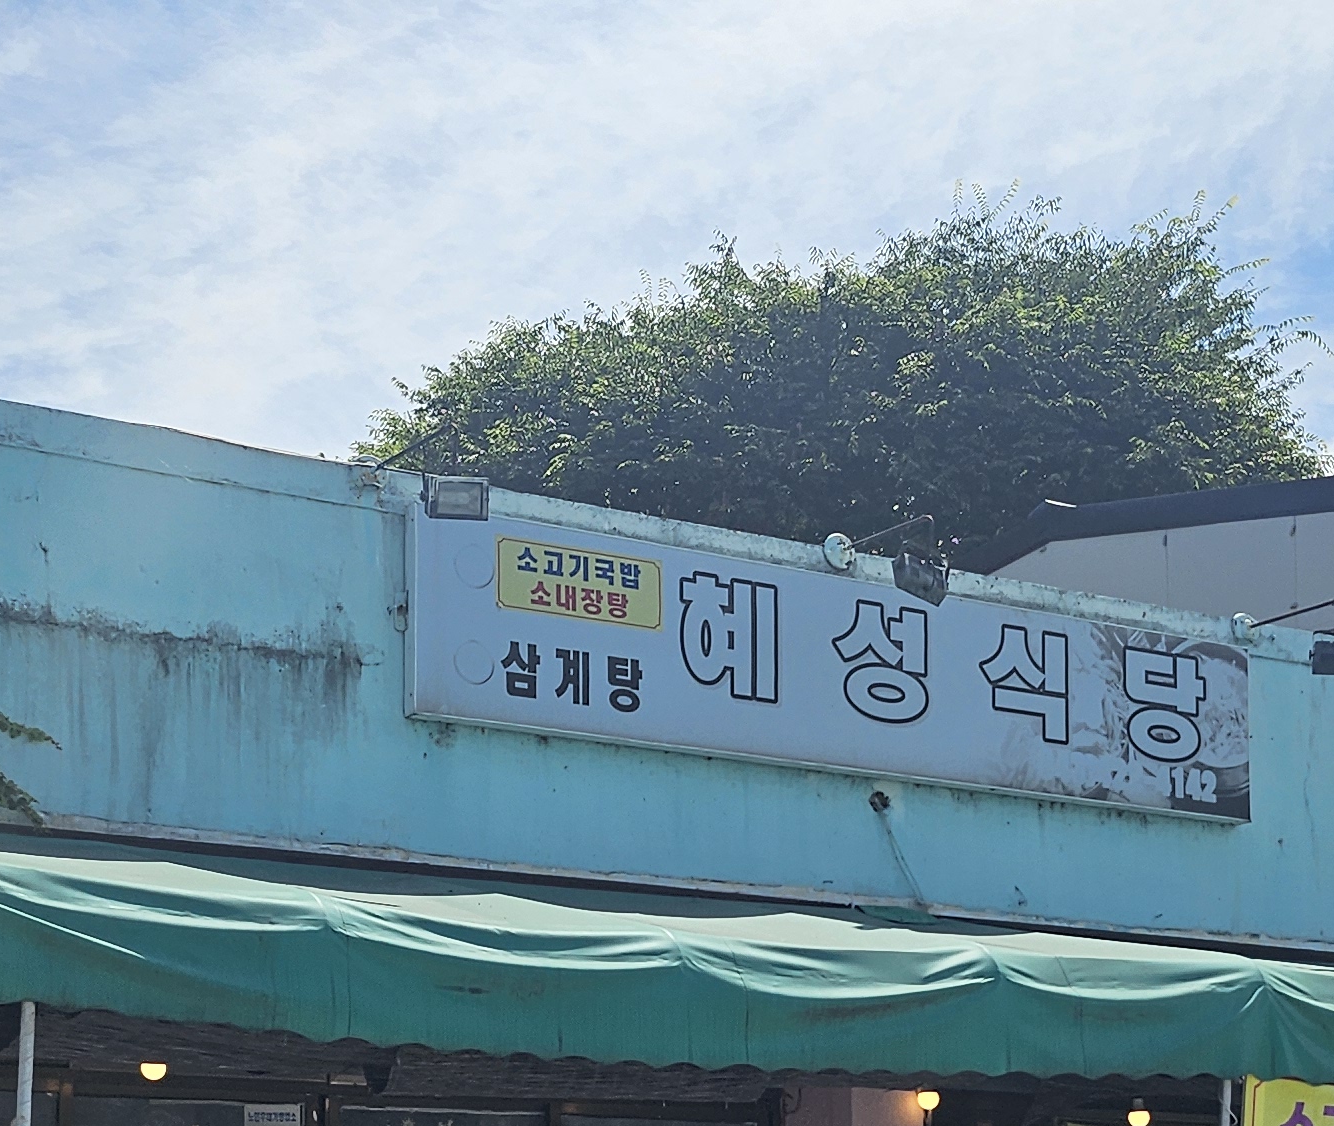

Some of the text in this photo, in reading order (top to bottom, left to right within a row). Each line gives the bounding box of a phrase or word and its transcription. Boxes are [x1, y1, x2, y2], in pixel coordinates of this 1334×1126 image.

[517, 547, 641, 590] 소고기국밥
[531, 581, 629, 619] 소내장탕
[500, 641, 643, 713] 삼계탕
[679, 570, 1207, 762] 혜성식당
